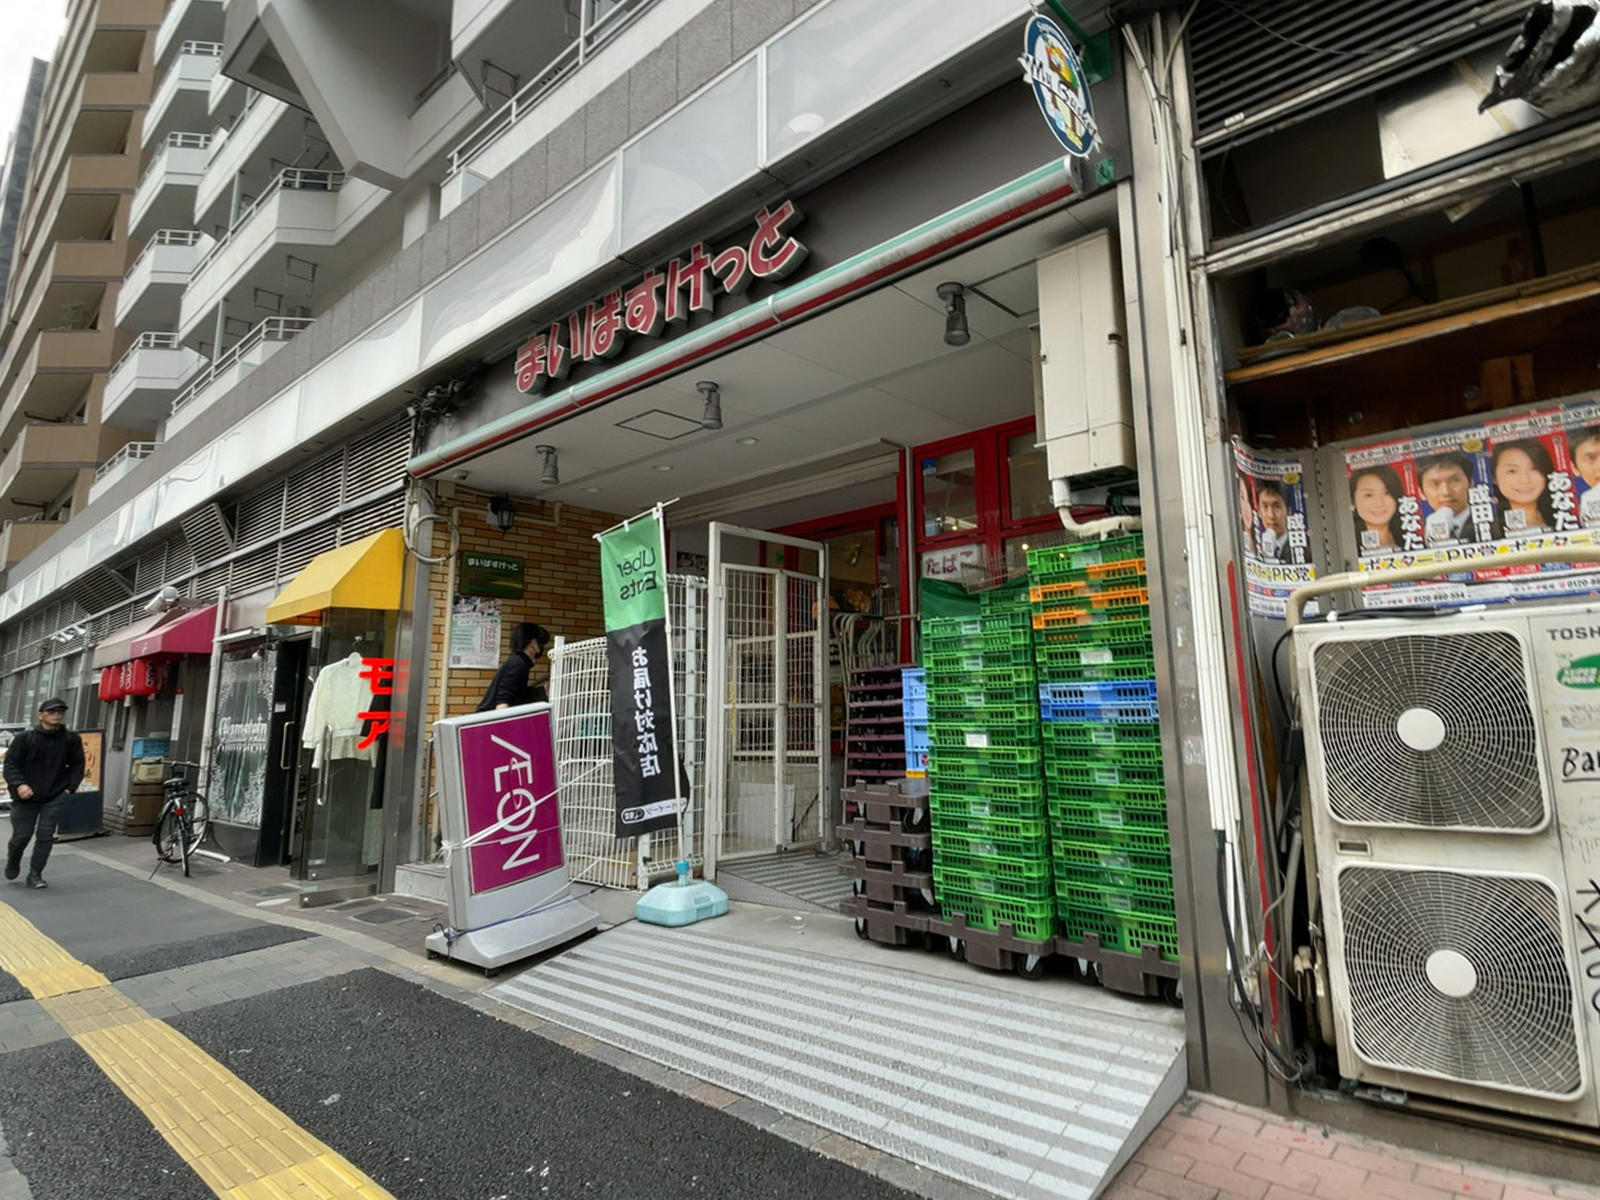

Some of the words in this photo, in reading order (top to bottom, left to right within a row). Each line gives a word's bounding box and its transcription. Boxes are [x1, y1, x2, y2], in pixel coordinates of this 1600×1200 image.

[514, 199, 803, 394] まいばすけっと
[1398, 495, 1425, 551] あなた
[1547, 471, 1580, 532] あなた
[357, 657, 396, 750] モア
[490, 733, 540, 871] AEON
